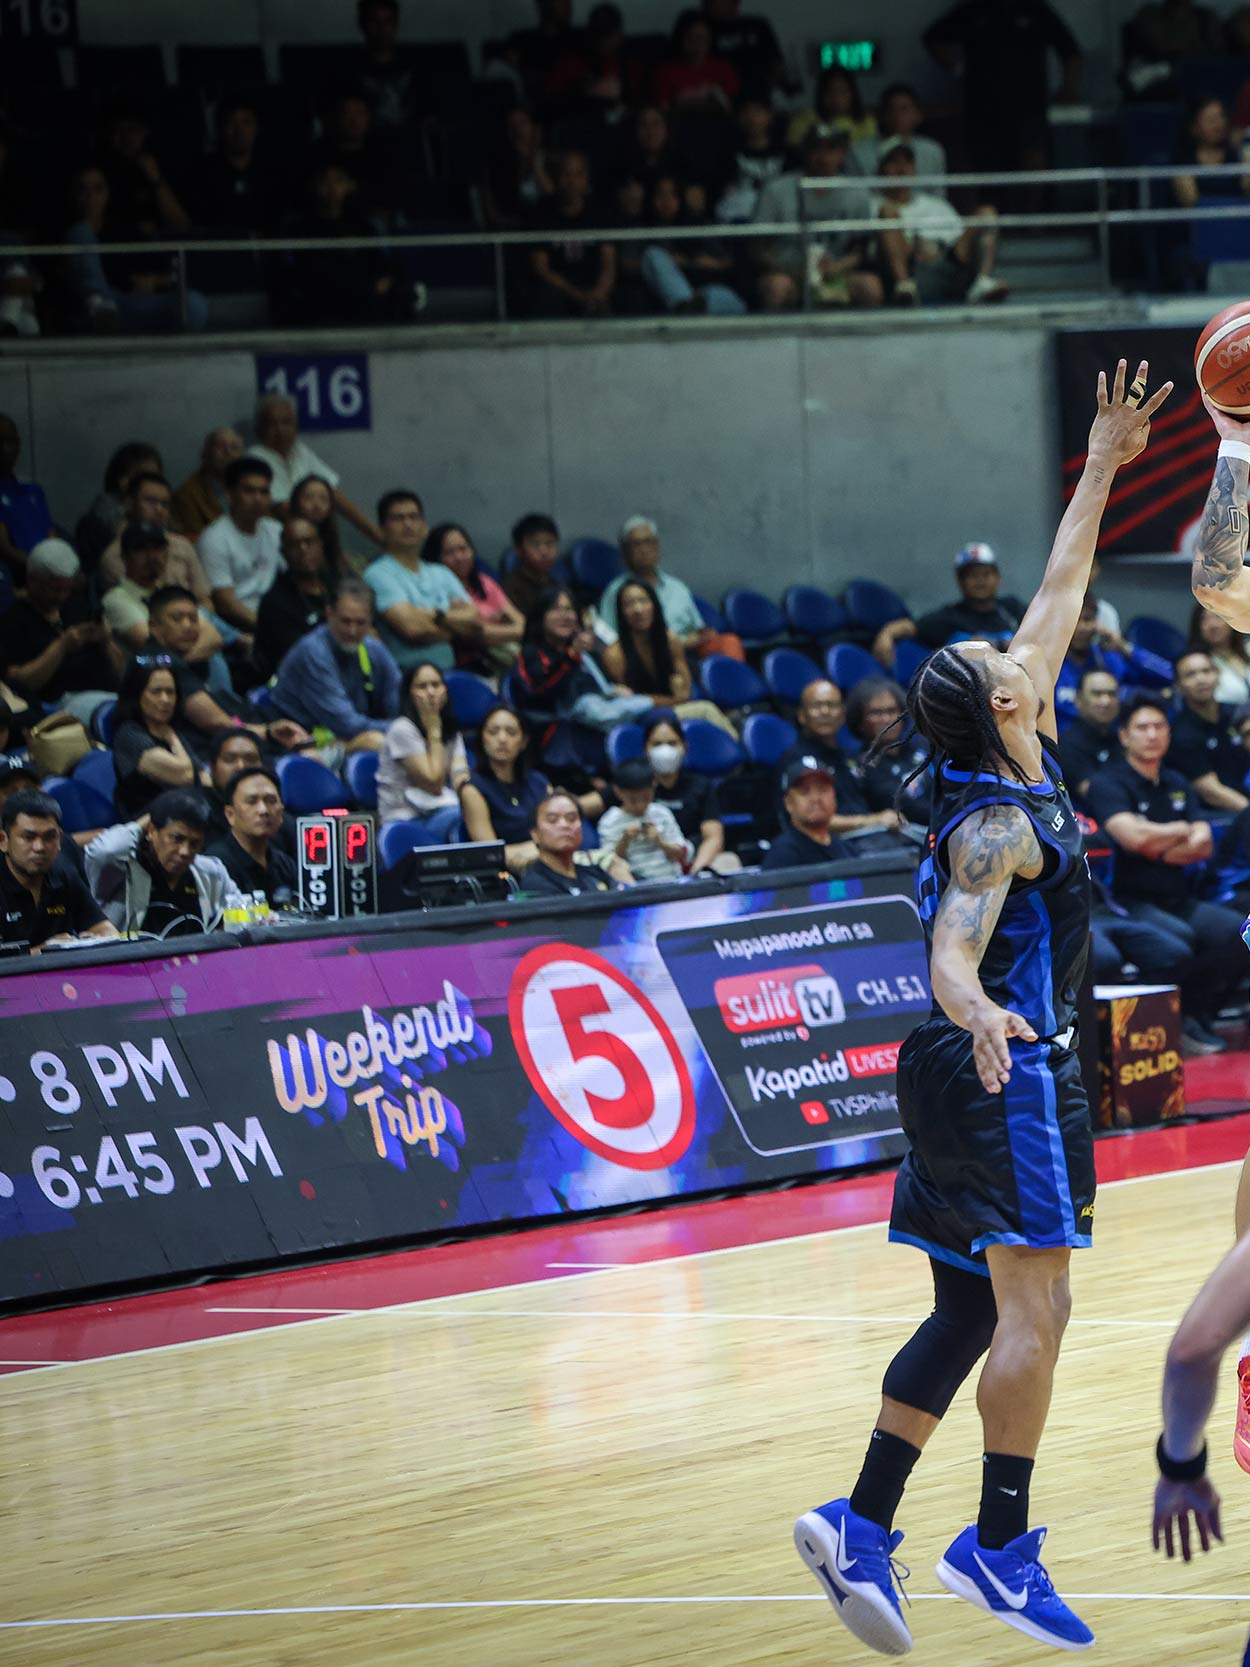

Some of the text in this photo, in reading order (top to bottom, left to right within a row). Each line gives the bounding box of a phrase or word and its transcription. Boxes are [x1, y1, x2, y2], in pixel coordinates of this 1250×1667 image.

[0, 0, 71, 36] 16
[713, 922, 874, 960] Mapapanood din sa
[728, 979, 834, 1026] sulit tv
[897, 975, 927, 1001] 5.1
[266, 979, 474, 1114] Weekend
[550, 983, 656, 1130] 5
[1120, 1049, 1179, 1086] SOLID
[30, 1037, 189, 1114] 8 PM
[744, 1050, 849, 1102] Kapatid
[353, 1073, 447, 1158] Trip
[31, 1116, 283, 1209] 6:45 PM
